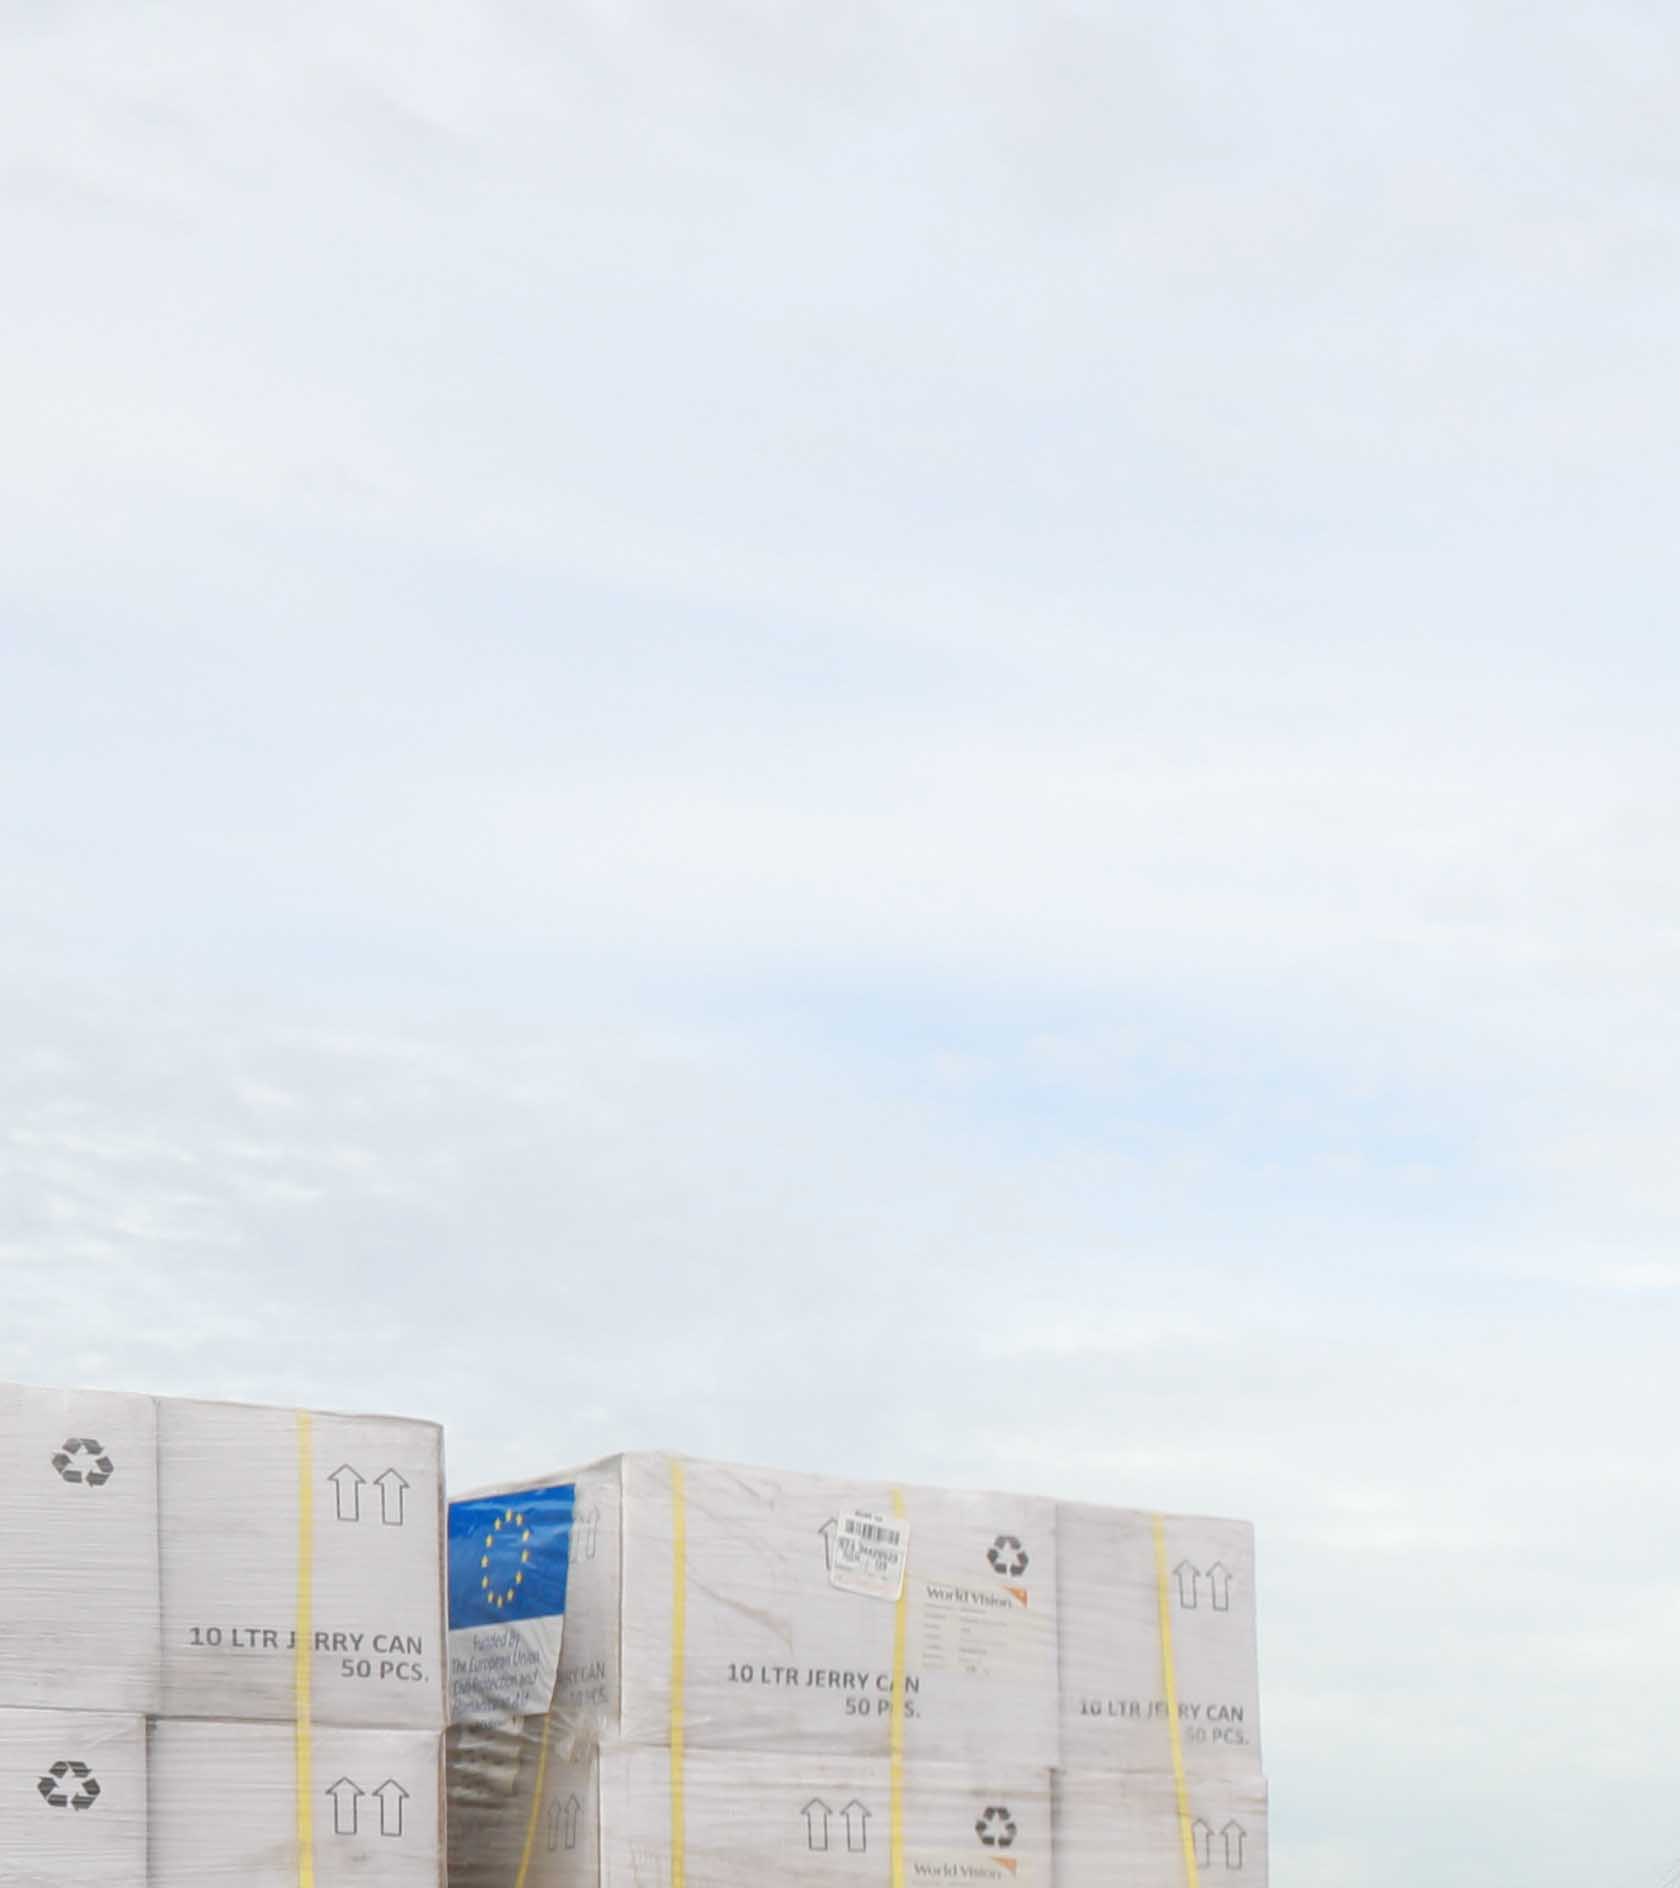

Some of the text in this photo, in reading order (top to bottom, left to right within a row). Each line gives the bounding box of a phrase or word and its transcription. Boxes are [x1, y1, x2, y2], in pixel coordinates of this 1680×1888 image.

[926, 1585, 1012, 1608] World Vision
[189, 1627, 422, 1654] 10 LTR CAN
[341, 1659, 429, 1682] 50 PCS.
[728, 1663, 869, 1691] 10 LTR JERRY
[845, 1698, 871, 1717] 50
[1208, 1704, 1244, 1722] CAN
